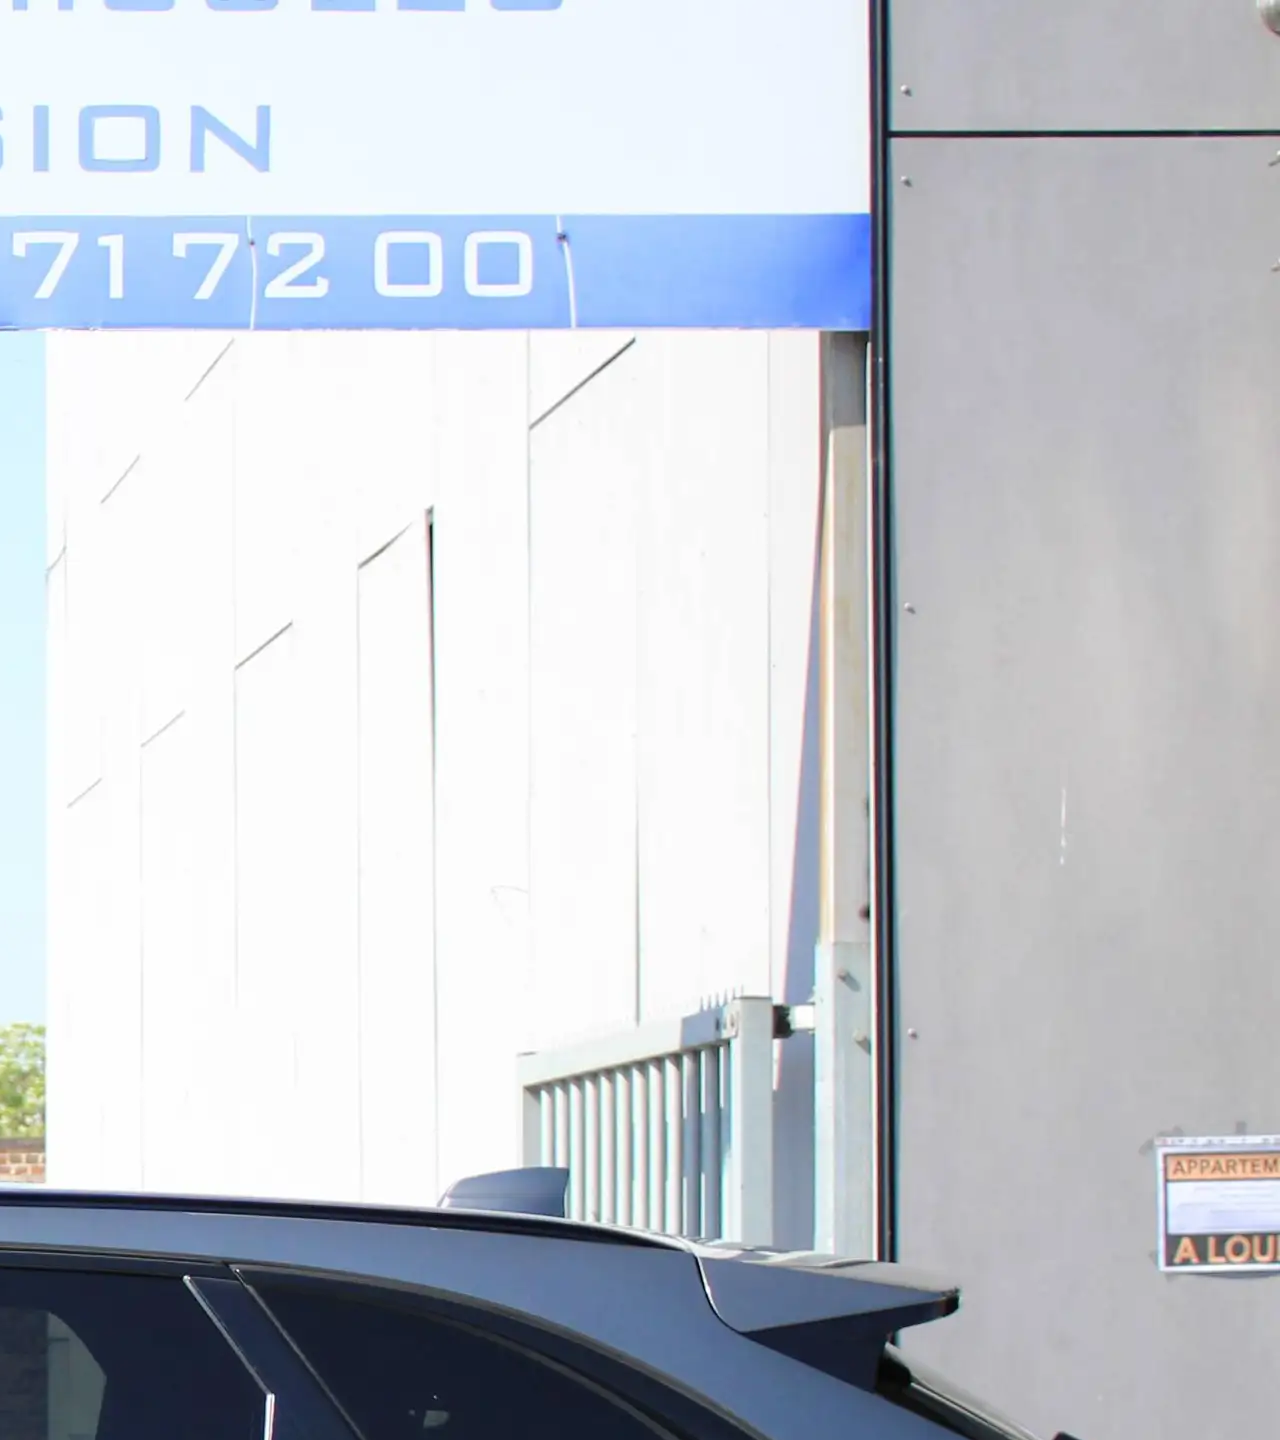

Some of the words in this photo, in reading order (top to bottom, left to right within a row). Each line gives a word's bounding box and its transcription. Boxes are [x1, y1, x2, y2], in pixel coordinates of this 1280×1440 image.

[171, 231, 330, 298] 72
[373, 230, 534, 297] 00
[1173, 1235, 1200, 1264] A
[1207, 1233, 1280, 1264] LOU
